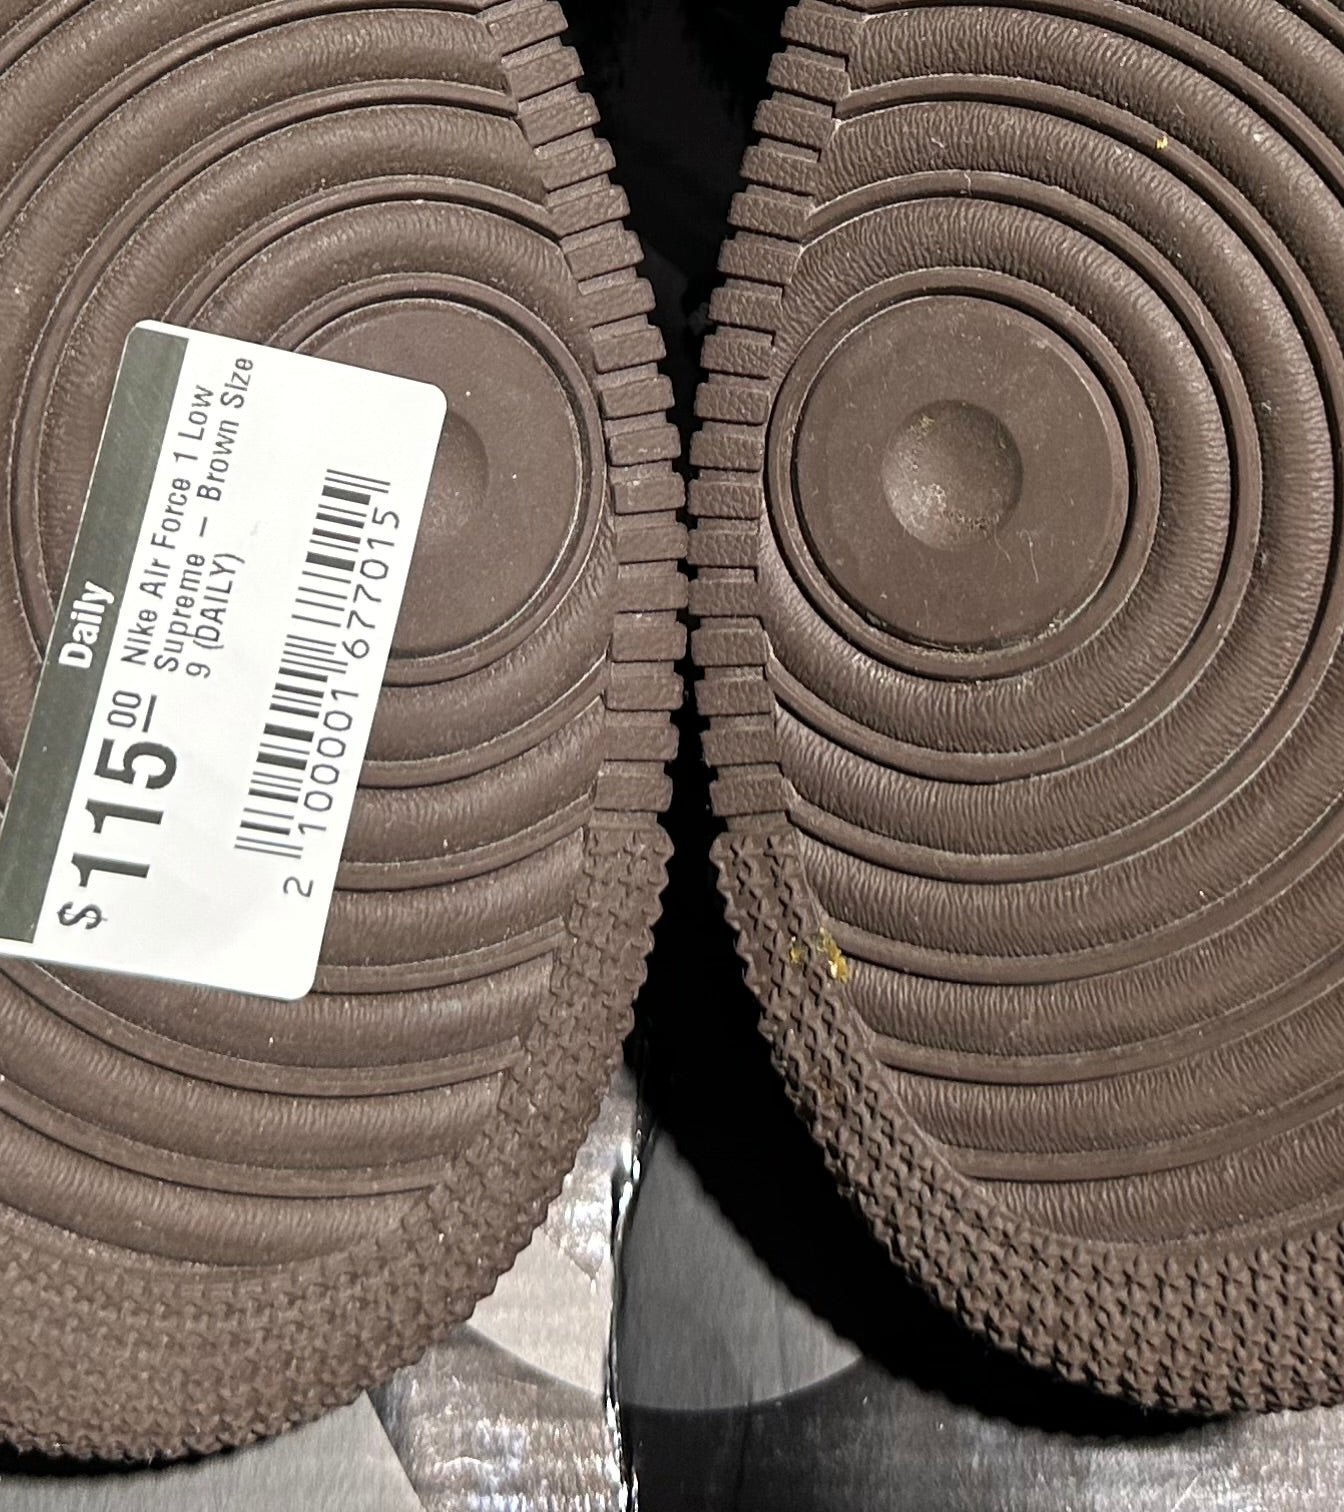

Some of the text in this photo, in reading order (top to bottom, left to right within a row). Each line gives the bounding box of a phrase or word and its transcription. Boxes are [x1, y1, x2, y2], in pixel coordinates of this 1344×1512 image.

[58, 580, 115, 669] Daily
[120, 384, 213, 665] Nike Air Force 1 Low
[152, 553, 205, 672] Supreme
[195, 419, 239, 501] Brown
[219, 357, 253, 409] Size
[185, 552, 245, 678] 9 (DAILY)
[282, 506, 400, 898] 2 100001 677015
